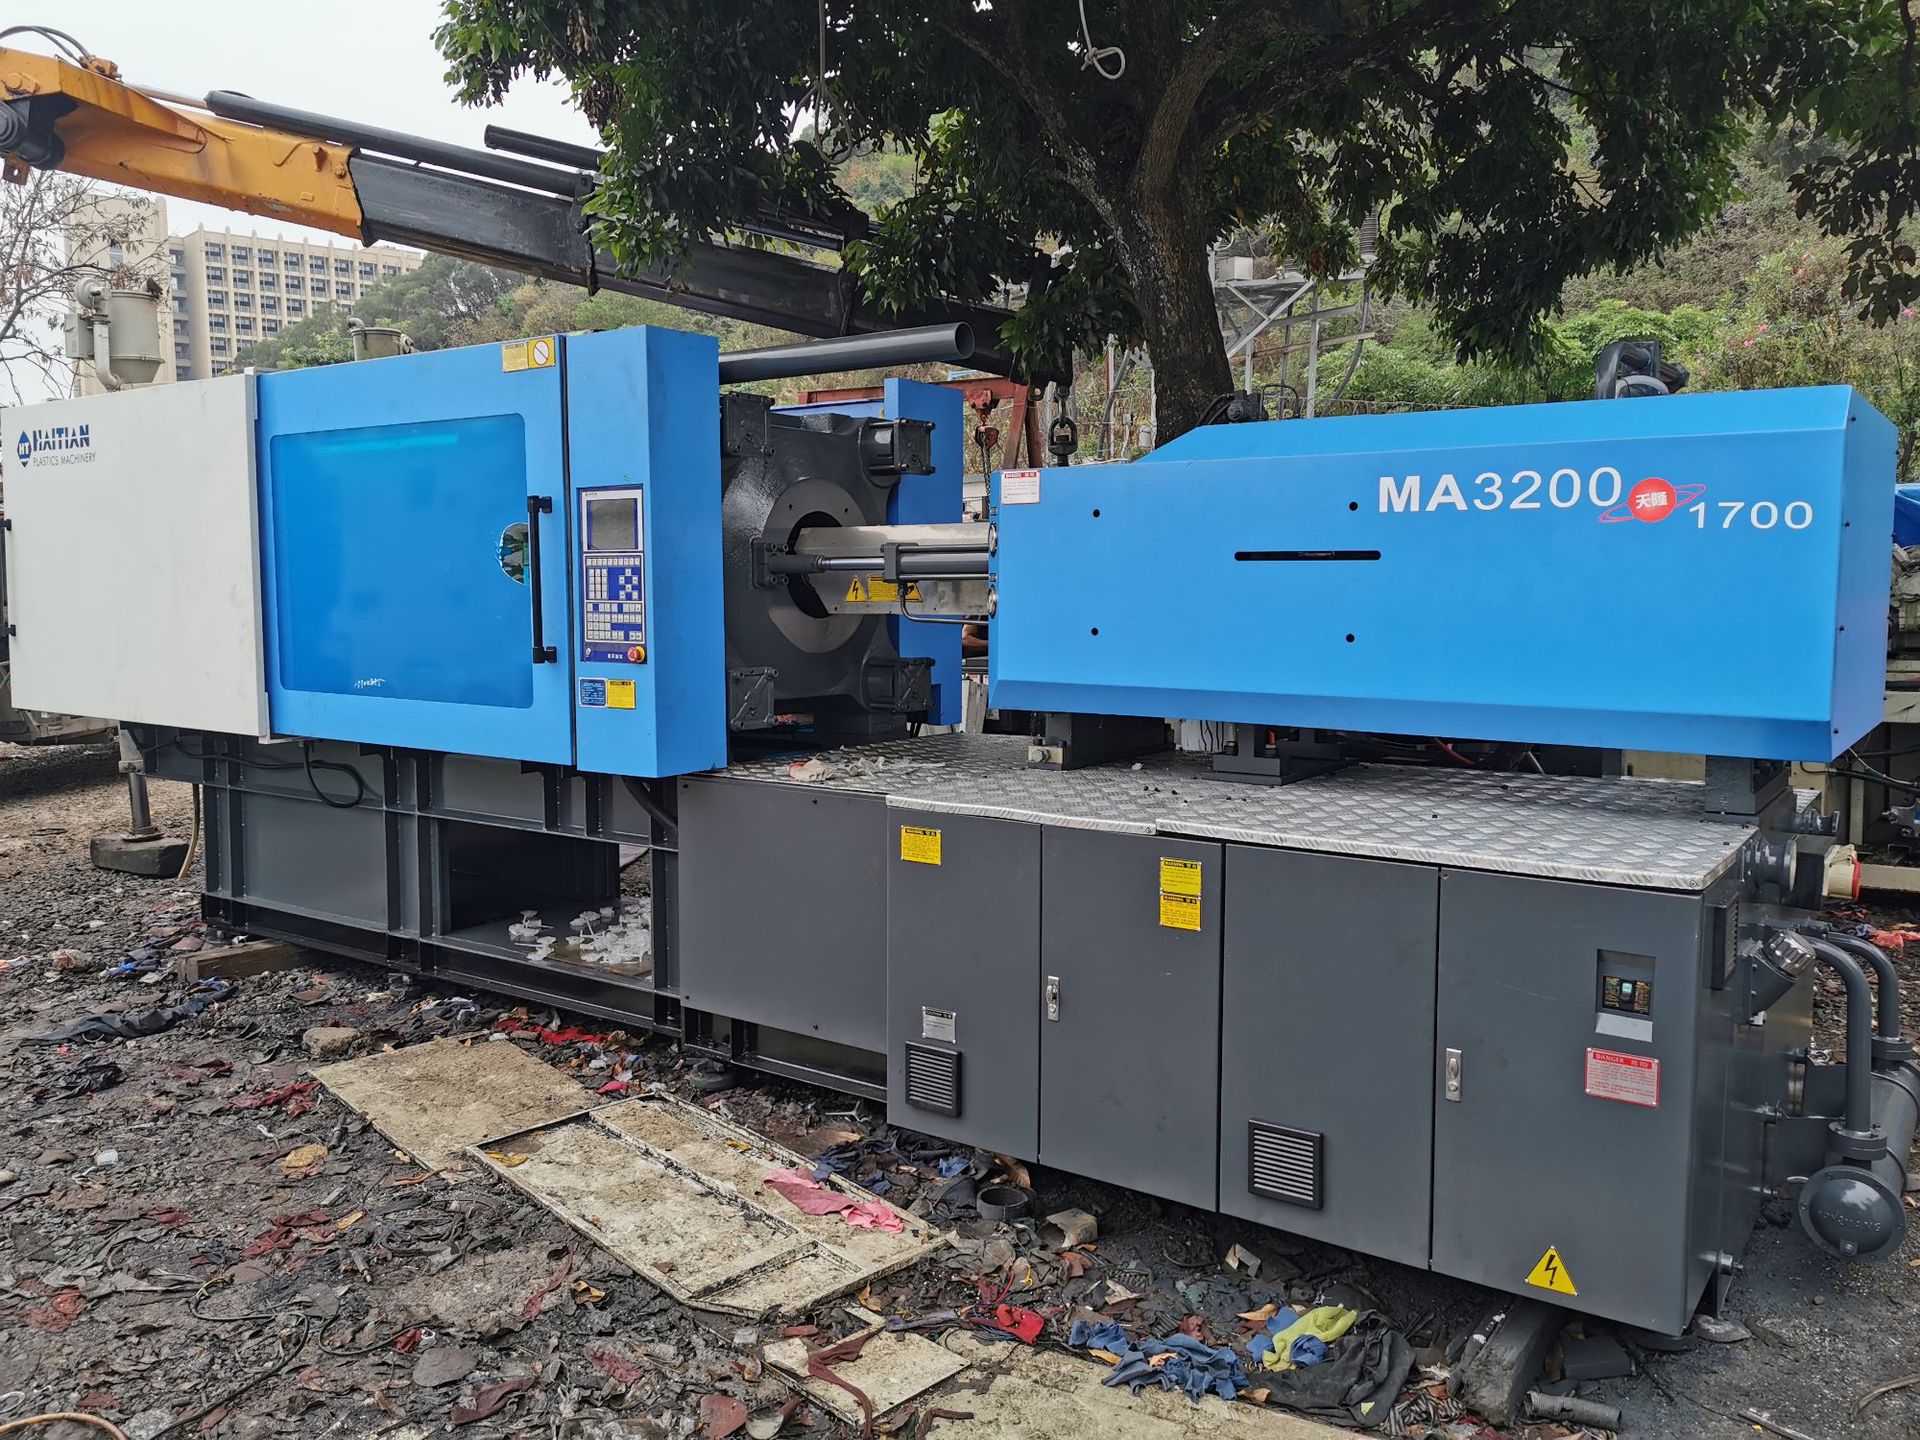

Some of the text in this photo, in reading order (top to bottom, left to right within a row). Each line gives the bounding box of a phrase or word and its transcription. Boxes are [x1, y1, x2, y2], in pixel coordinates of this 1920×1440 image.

[33, 424, 90, 451] HAITIAN
[33, 452, 96, 467] PLASTICS MACHINERY
[1378, 466, 1622, 513] MA3200
[1688, 501, 1814, 530] 1700
[1595, 1053, 1624, 1064] DANGER
